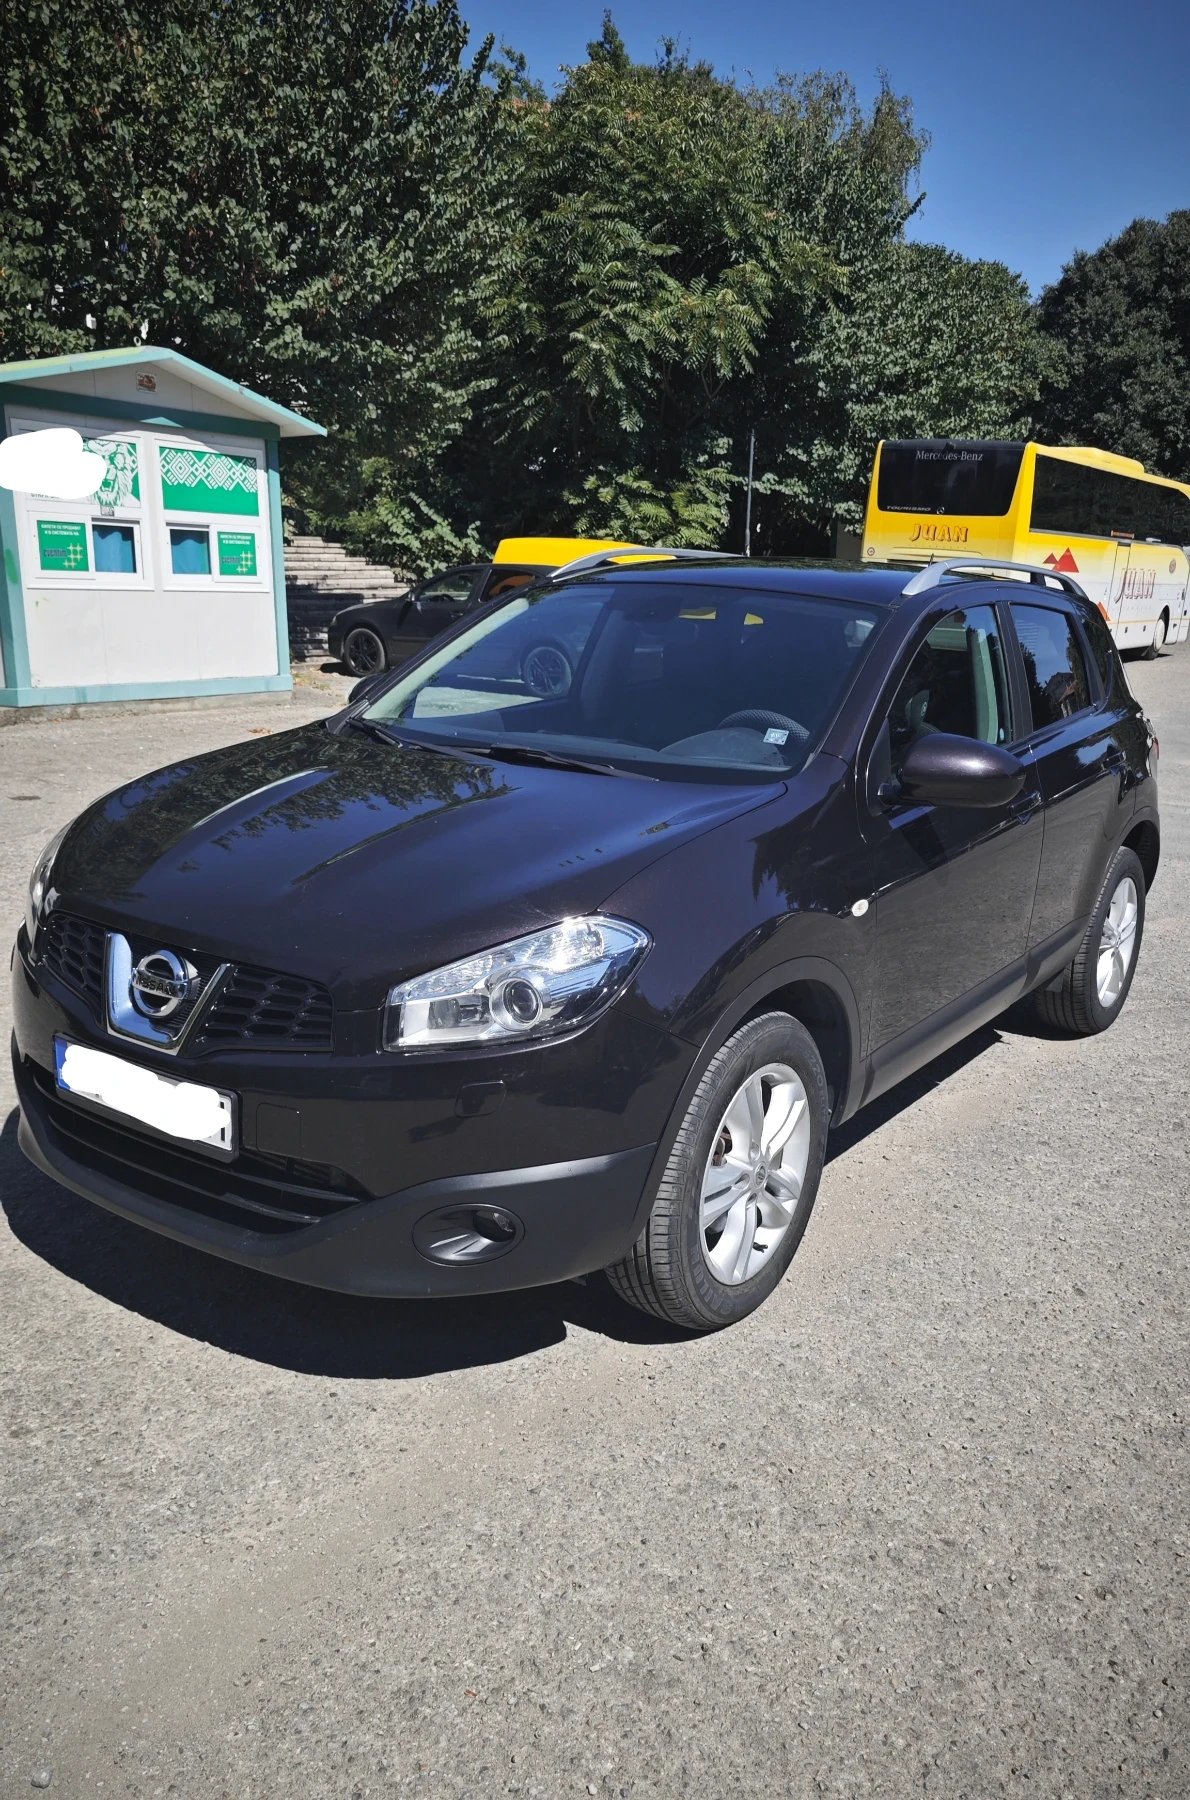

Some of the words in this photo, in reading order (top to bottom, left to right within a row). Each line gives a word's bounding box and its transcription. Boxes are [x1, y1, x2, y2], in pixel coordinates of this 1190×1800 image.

[915, 450, 984, 461] Mercedes-Benz
[909, 523, 968, 543] JUAN
[1114, 567, 1156, 604] JUAN
[136, 974, 176, 996] NISSAN
[689, 1243, 734, 1316] SAILUN
